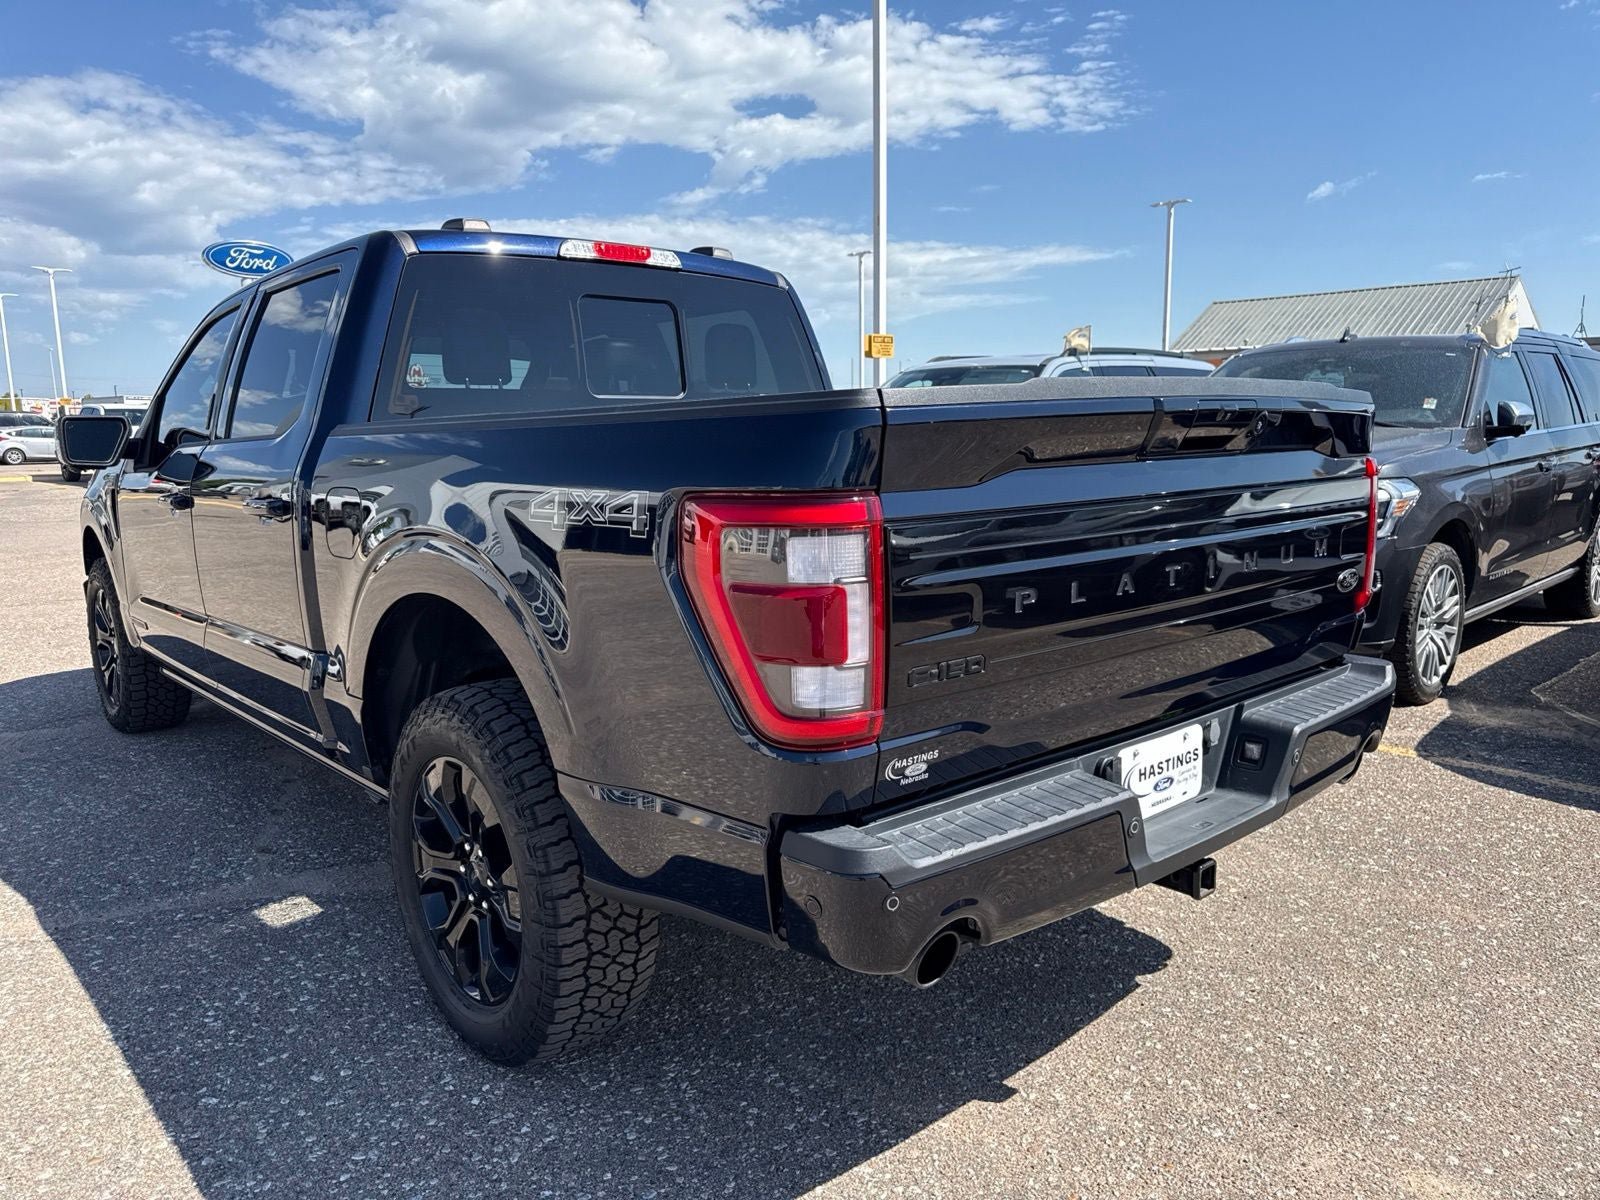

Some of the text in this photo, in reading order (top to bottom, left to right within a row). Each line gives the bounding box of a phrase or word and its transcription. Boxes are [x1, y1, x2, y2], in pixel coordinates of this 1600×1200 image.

[226, 247, 277, 270] Ford
[1013, 538, 1329, 614] PLATINUM
[894, 749, 939, 769] HASTINGS
[1138, 748, 1199, 782] HASTINGS
[899, 772, 929, 786] Nebraska
[1155, 778, 1173, 790] Ford
